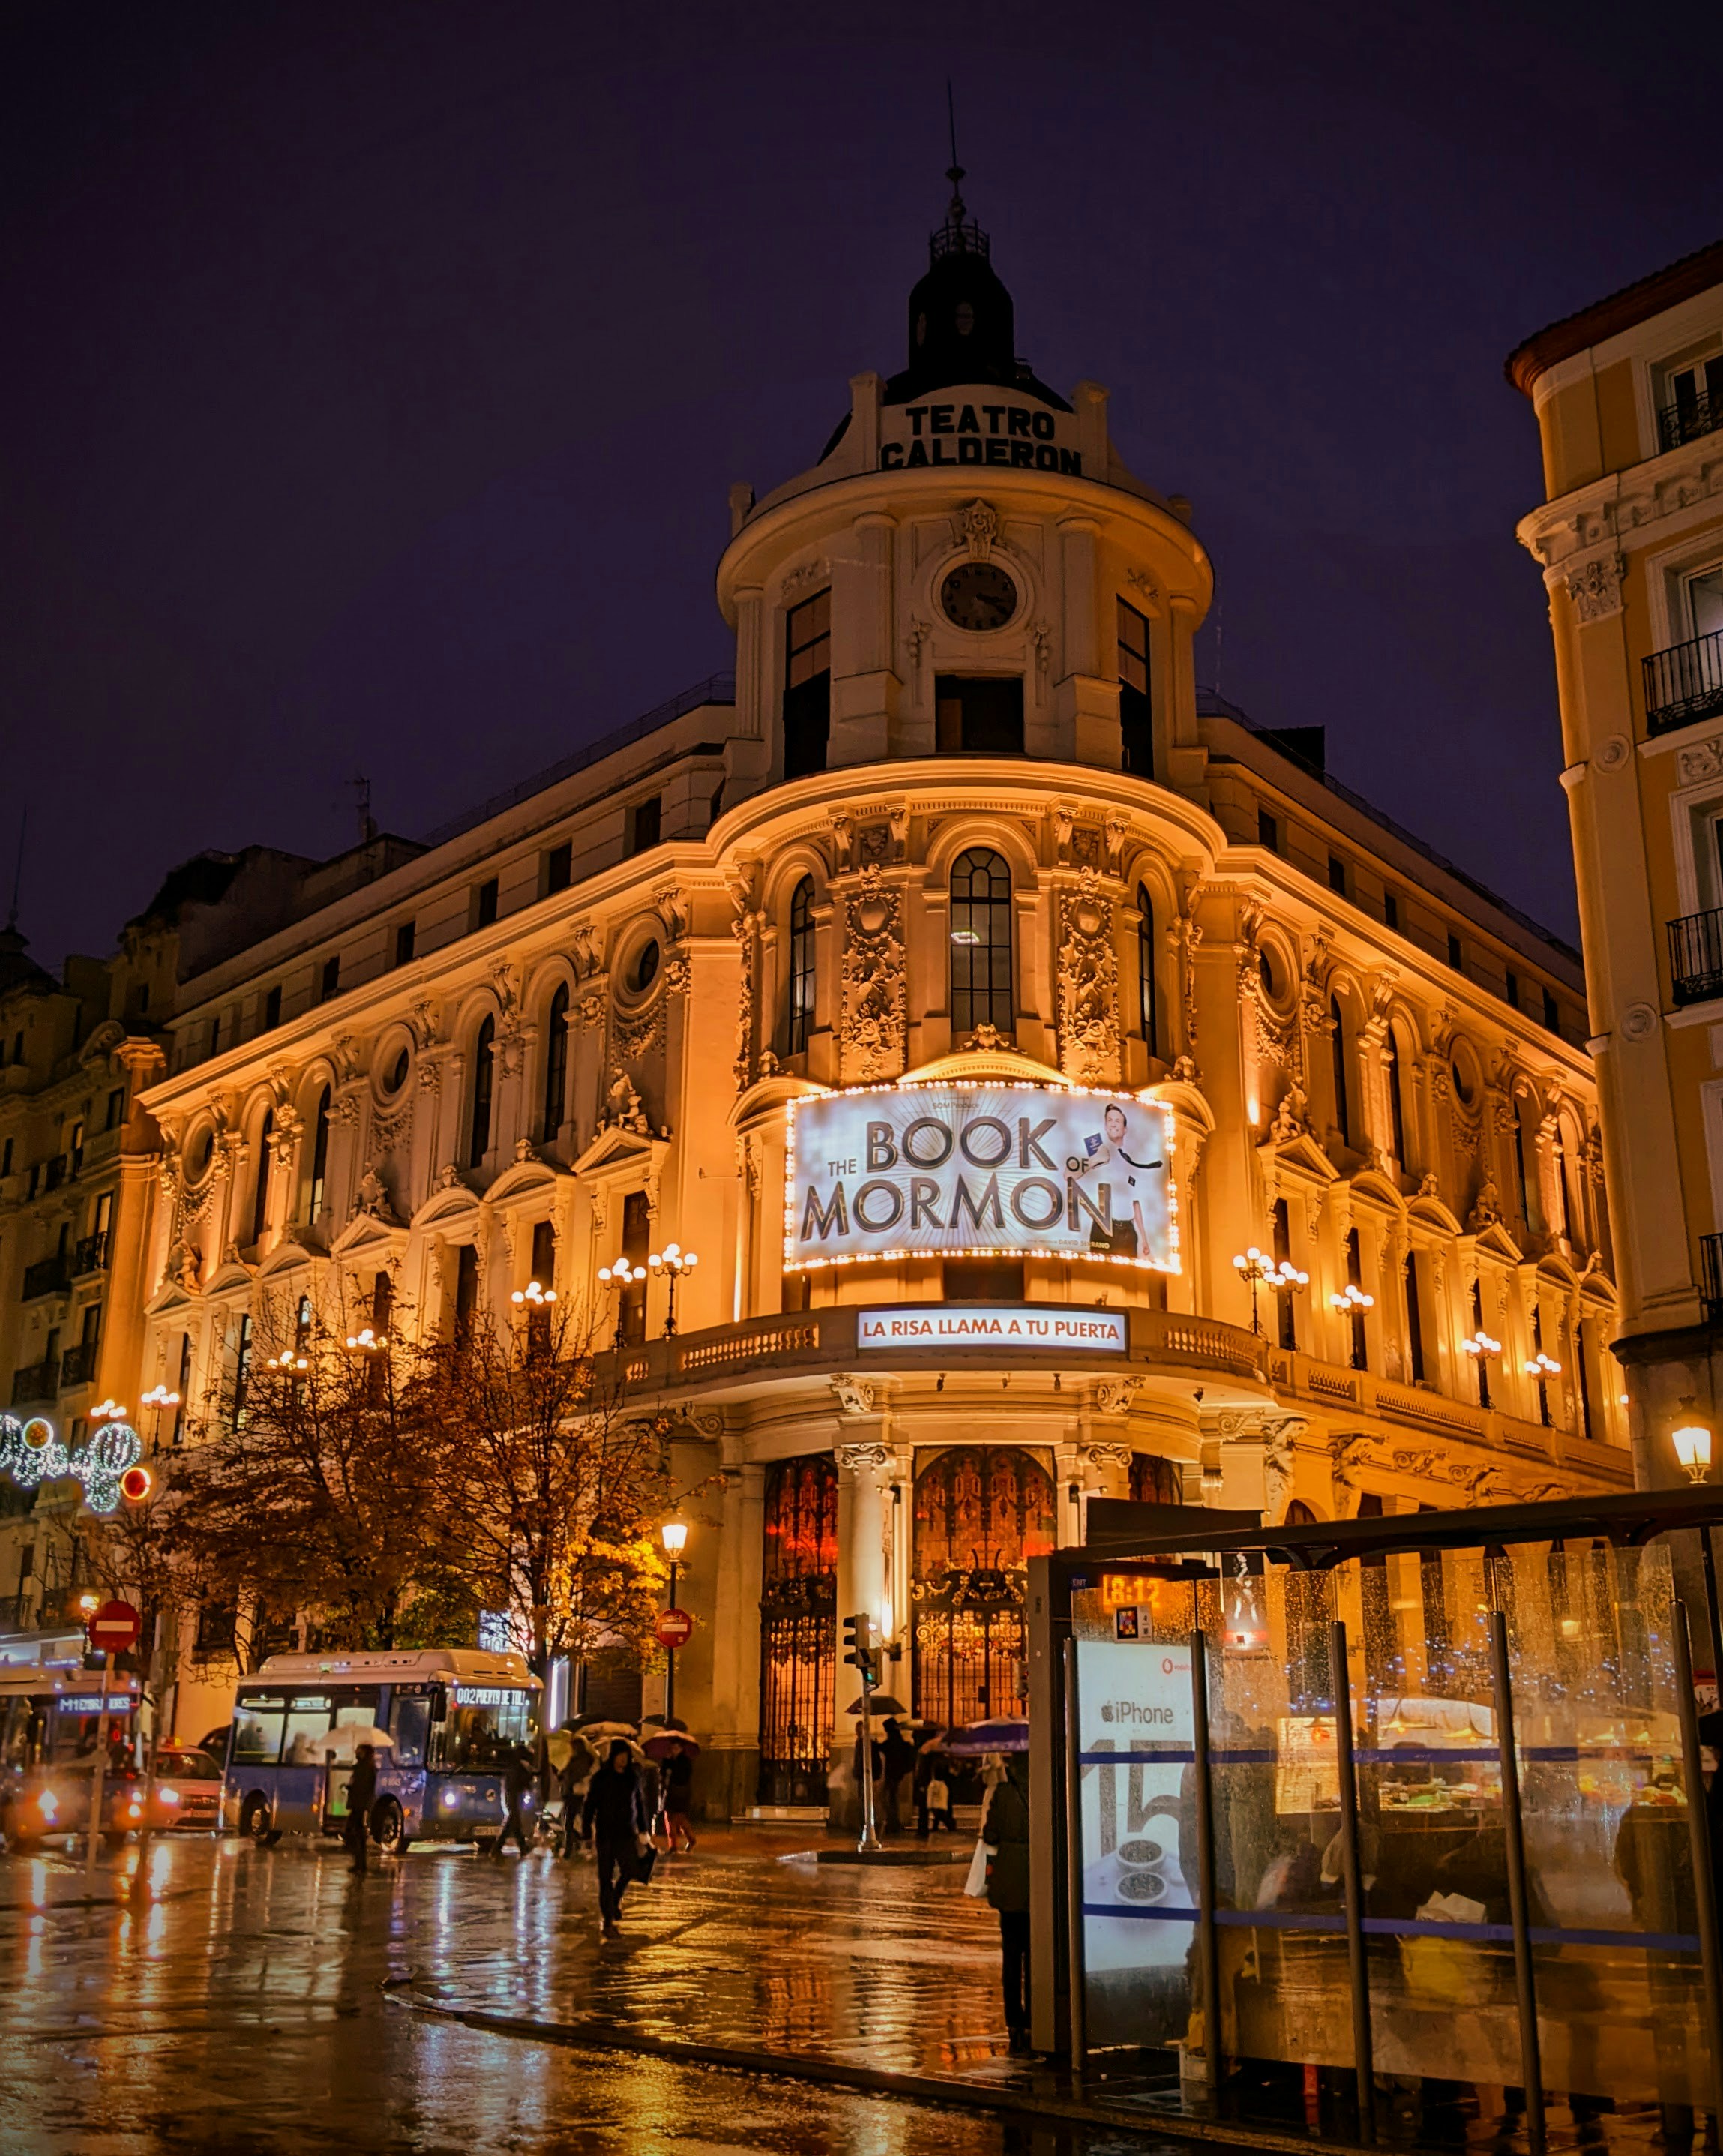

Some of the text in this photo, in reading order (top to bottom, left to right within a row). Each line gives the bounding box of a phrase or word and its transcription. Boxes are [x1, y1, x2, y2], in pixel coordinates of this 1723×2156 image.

[905, 404, 1055, 441] TEATRO
[880, 437, 1082, 476] CALDERON
[828, 1115, 1089, 1177] THE BOOK OF
[800, 1172, 1113, 1242] MORMON
[864, 1318, 1119, 1339] LA RISA LLAMA A TU PUERTA
[1116, 1701, 1173, 1724] iPhone
